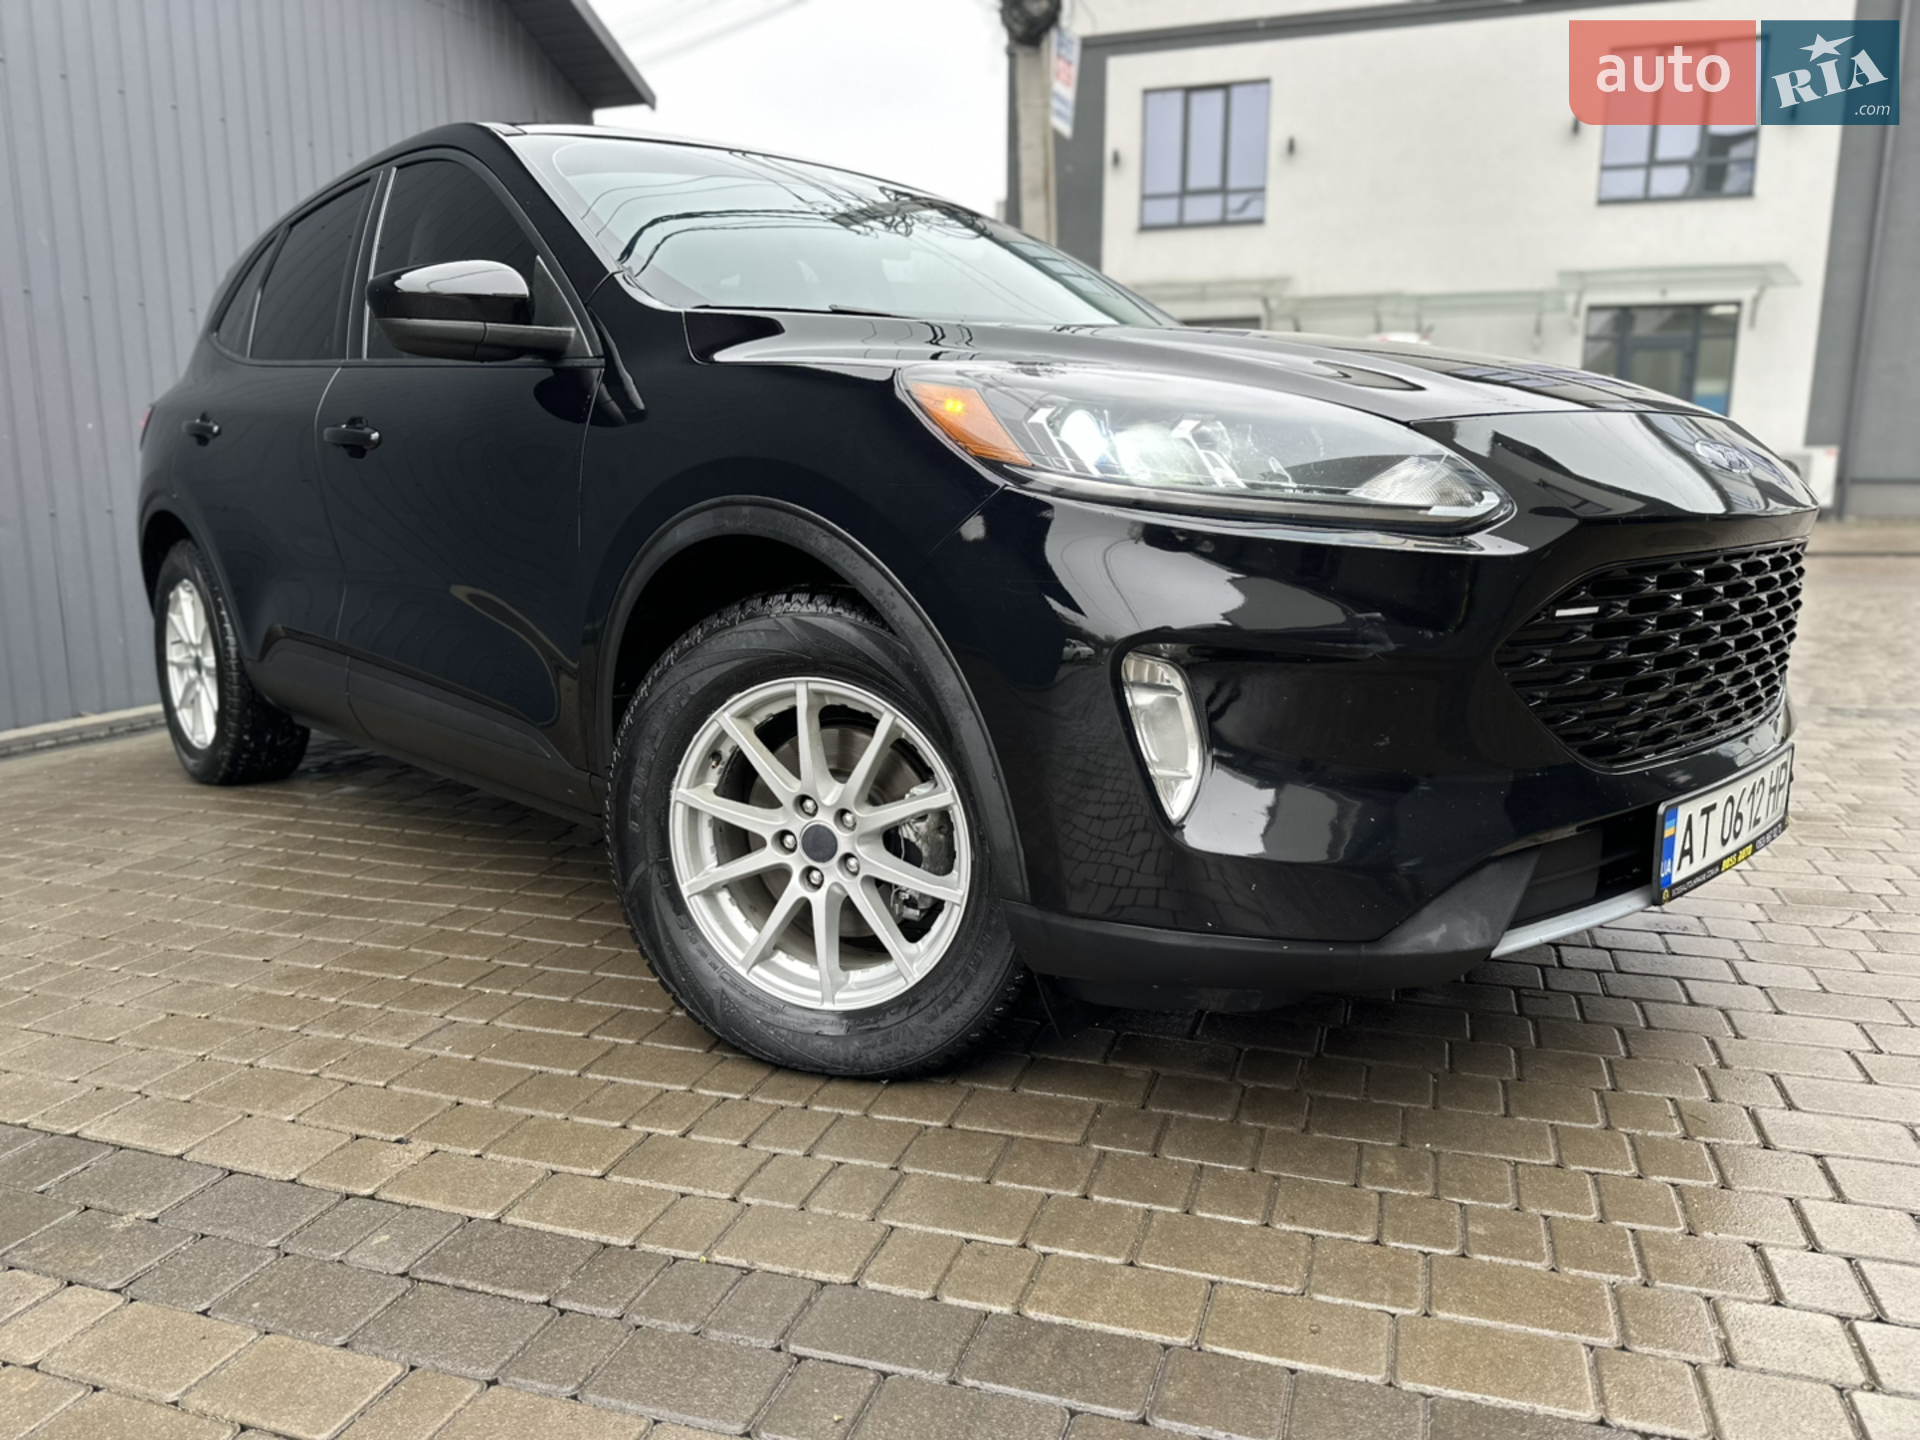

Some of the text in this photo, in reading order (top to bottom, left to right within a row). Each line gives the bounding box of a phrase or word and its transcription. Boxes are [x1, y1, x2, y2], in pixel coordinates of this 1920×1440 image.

[1677, 760, 1788, 871] AT 0612 HP
[1660, 858, 1672, 877] UA
